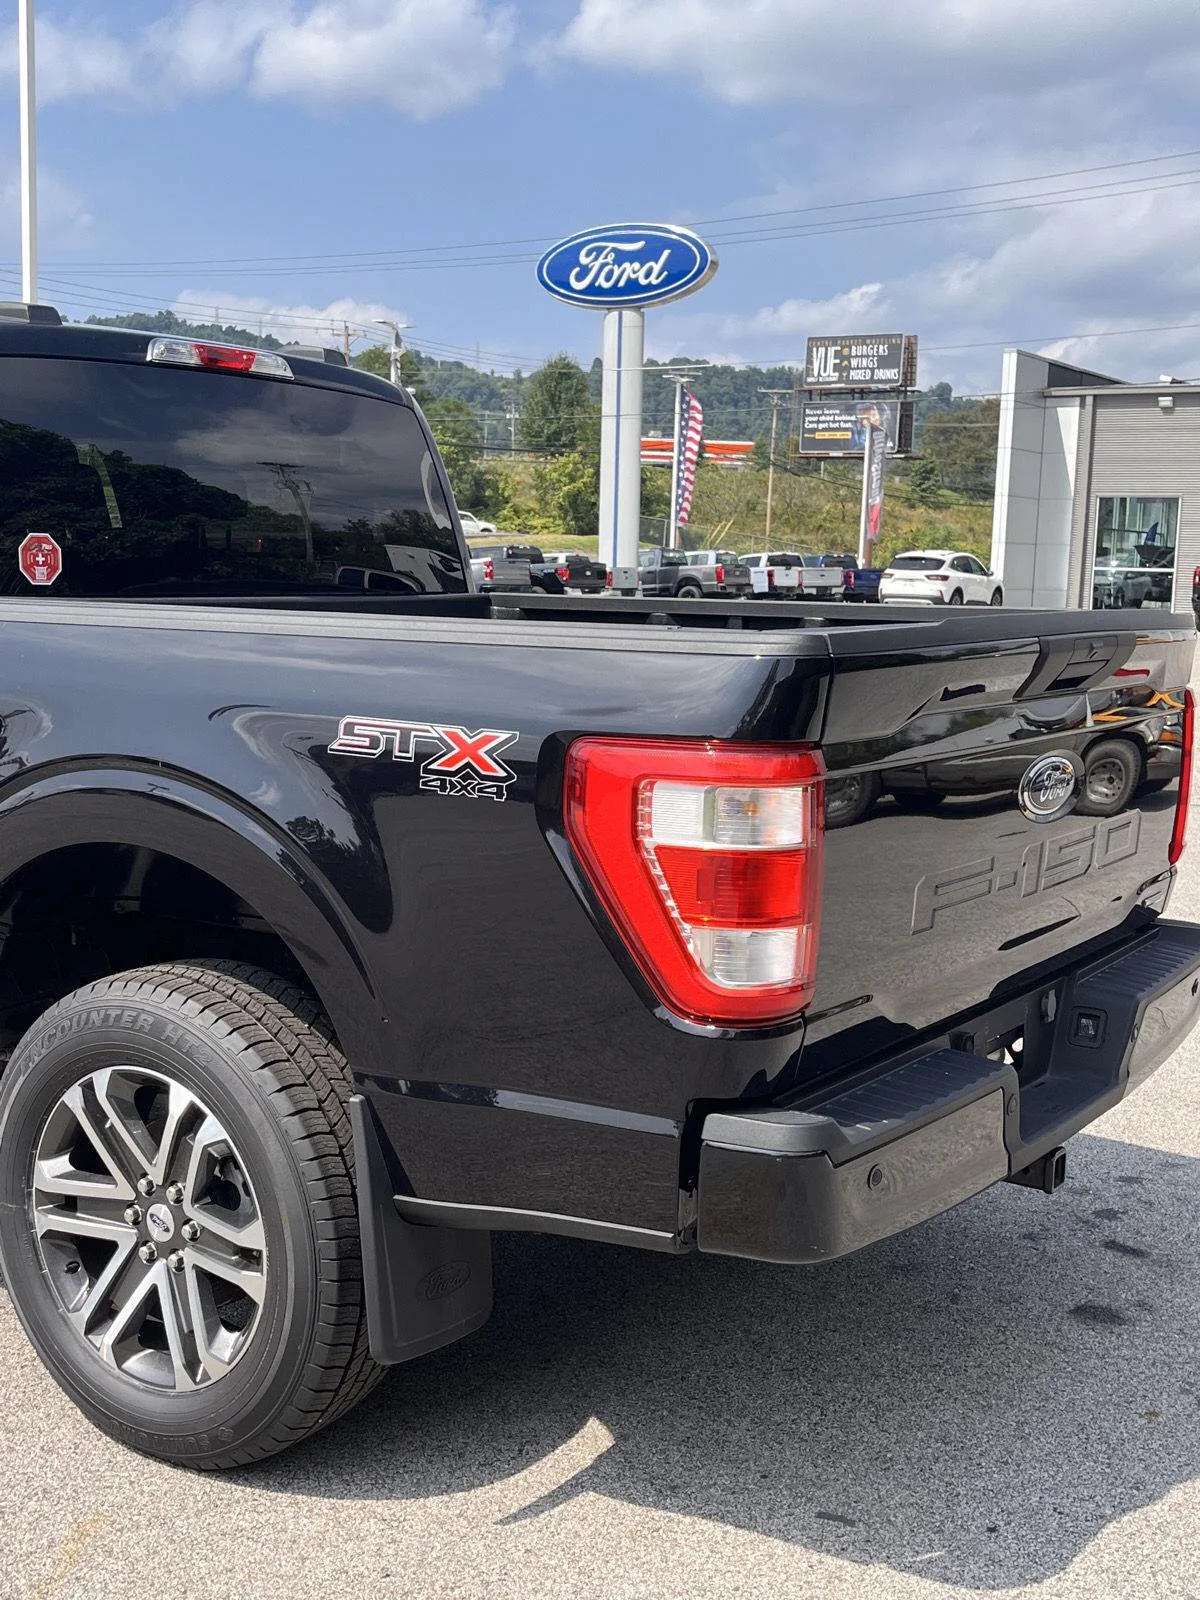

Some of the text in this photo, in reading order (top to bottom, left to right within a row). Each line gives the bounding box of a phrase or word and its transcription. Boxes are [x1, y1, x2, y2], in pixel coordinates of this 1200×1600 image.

[569, 240, 672, 291] Ford
[812, 346, 841, 377] VUE
[850, 357, 878, 368] WINGS
[851, 345, 889, 356] BURGERS
[849, 369, 871, 380] MIXED
[874, 368, 899, 380] DRINKS
[818, 422, 829, 430] get
[328, 715, 520, 785] STX
[1040, 769, 1069, 803] Ford
[911, 808, 1142, 937] F-150
[20, 1008, 154, 1077] ENCOUNTER
